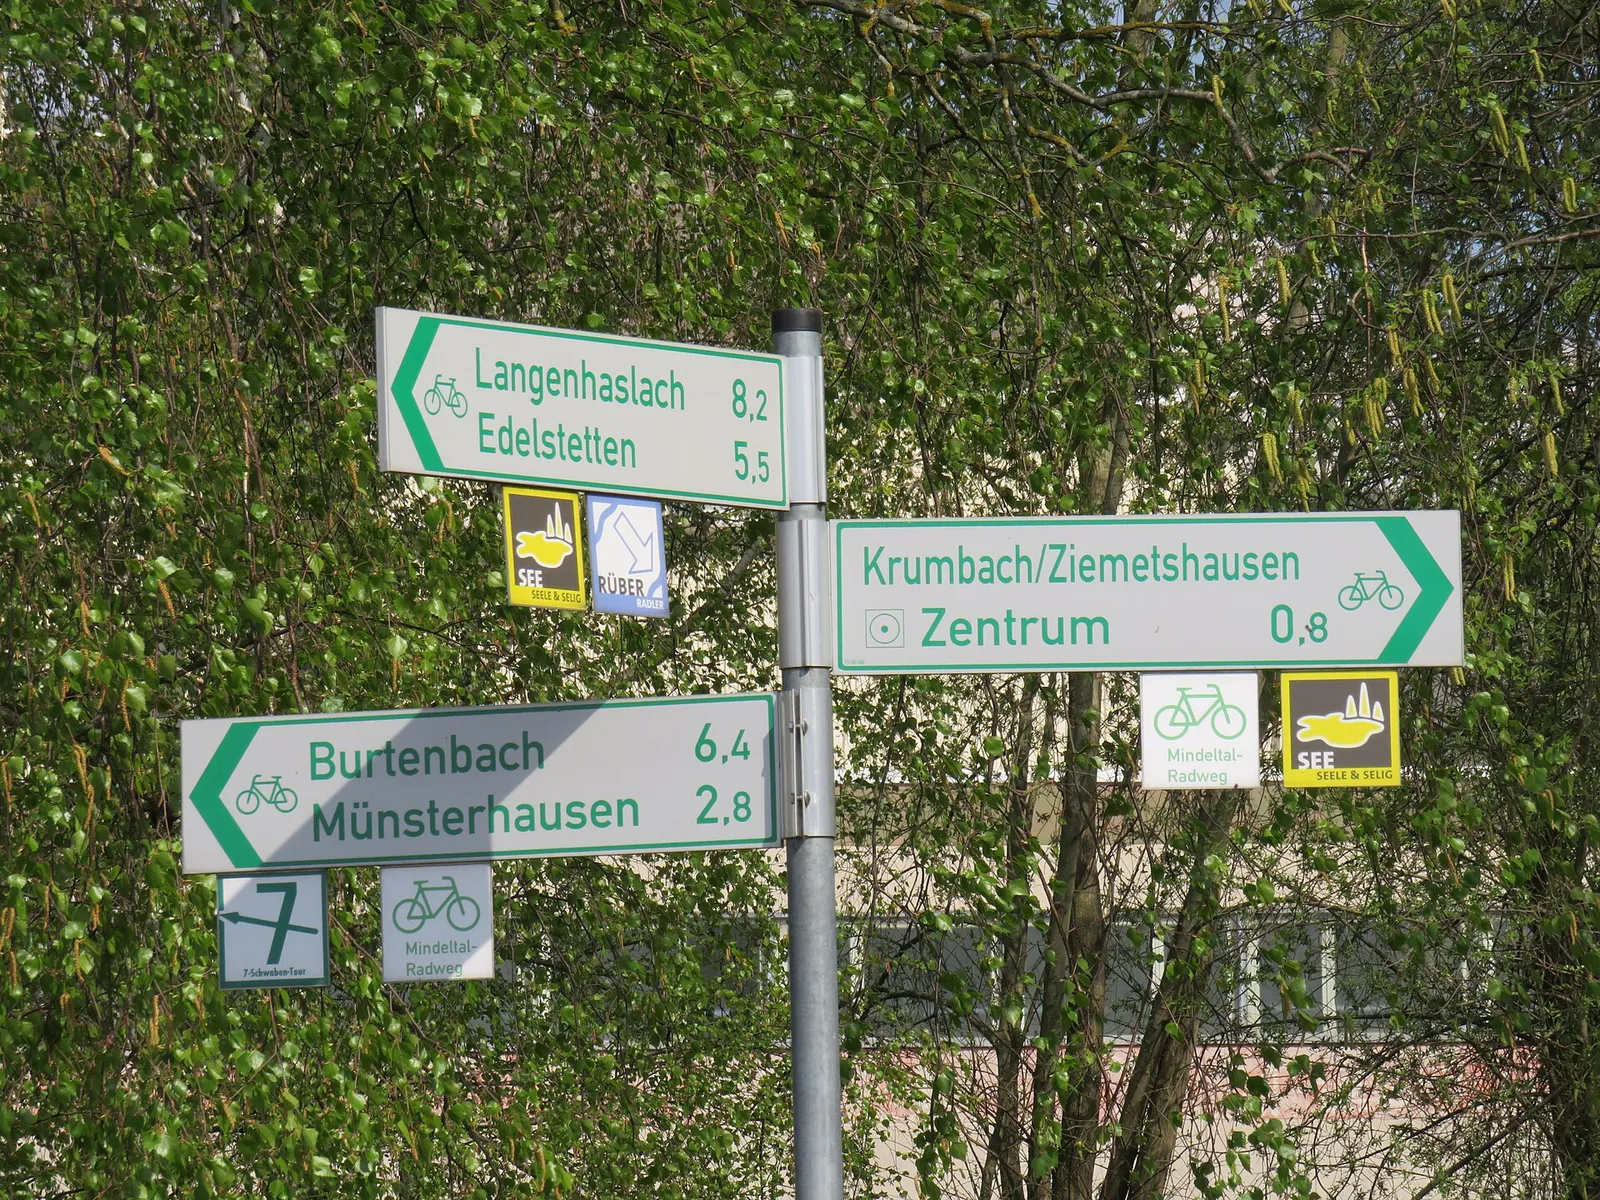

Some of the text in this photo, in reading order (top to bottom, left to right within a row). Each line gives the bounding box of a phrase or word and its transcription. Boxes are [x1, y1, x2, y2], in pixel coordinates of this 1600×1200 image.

[475, 346, 768, 422] Langenhaslach 8,2
[478, 412, 770, 484] Edelstetten 5,5
[863, 543, 1300, 586] Krumbach/Ziemetshausen
[518, 568, 543, 588] SEE
[598, 573, 644, 596] RÜBER
[532, 590, 581, 603] SEELE & SELIG
[636, 598, 664, 610] RADLER
[921, 604, 1329, 648] Zentrum 0,8
[309, 722, 751, 781] Burtenbach 6,4
[1167, 748, 1243, 762] Mindeltal-
[1297, 751, 1334, 769] SEE
[1168, 769, 1228, 785] Radweg
[1316, 770, 1393, 781] SEELE & SELIG
[312, 783, 752, 842] Münsterhausen 2,8
[256, 881, 297, 965] 7
[405, 939, 477, 955] Mindeltal-
[243, 967, 306, 978] 7-Schwaben-Tour
[406, 963, 463, 978] Radweg
